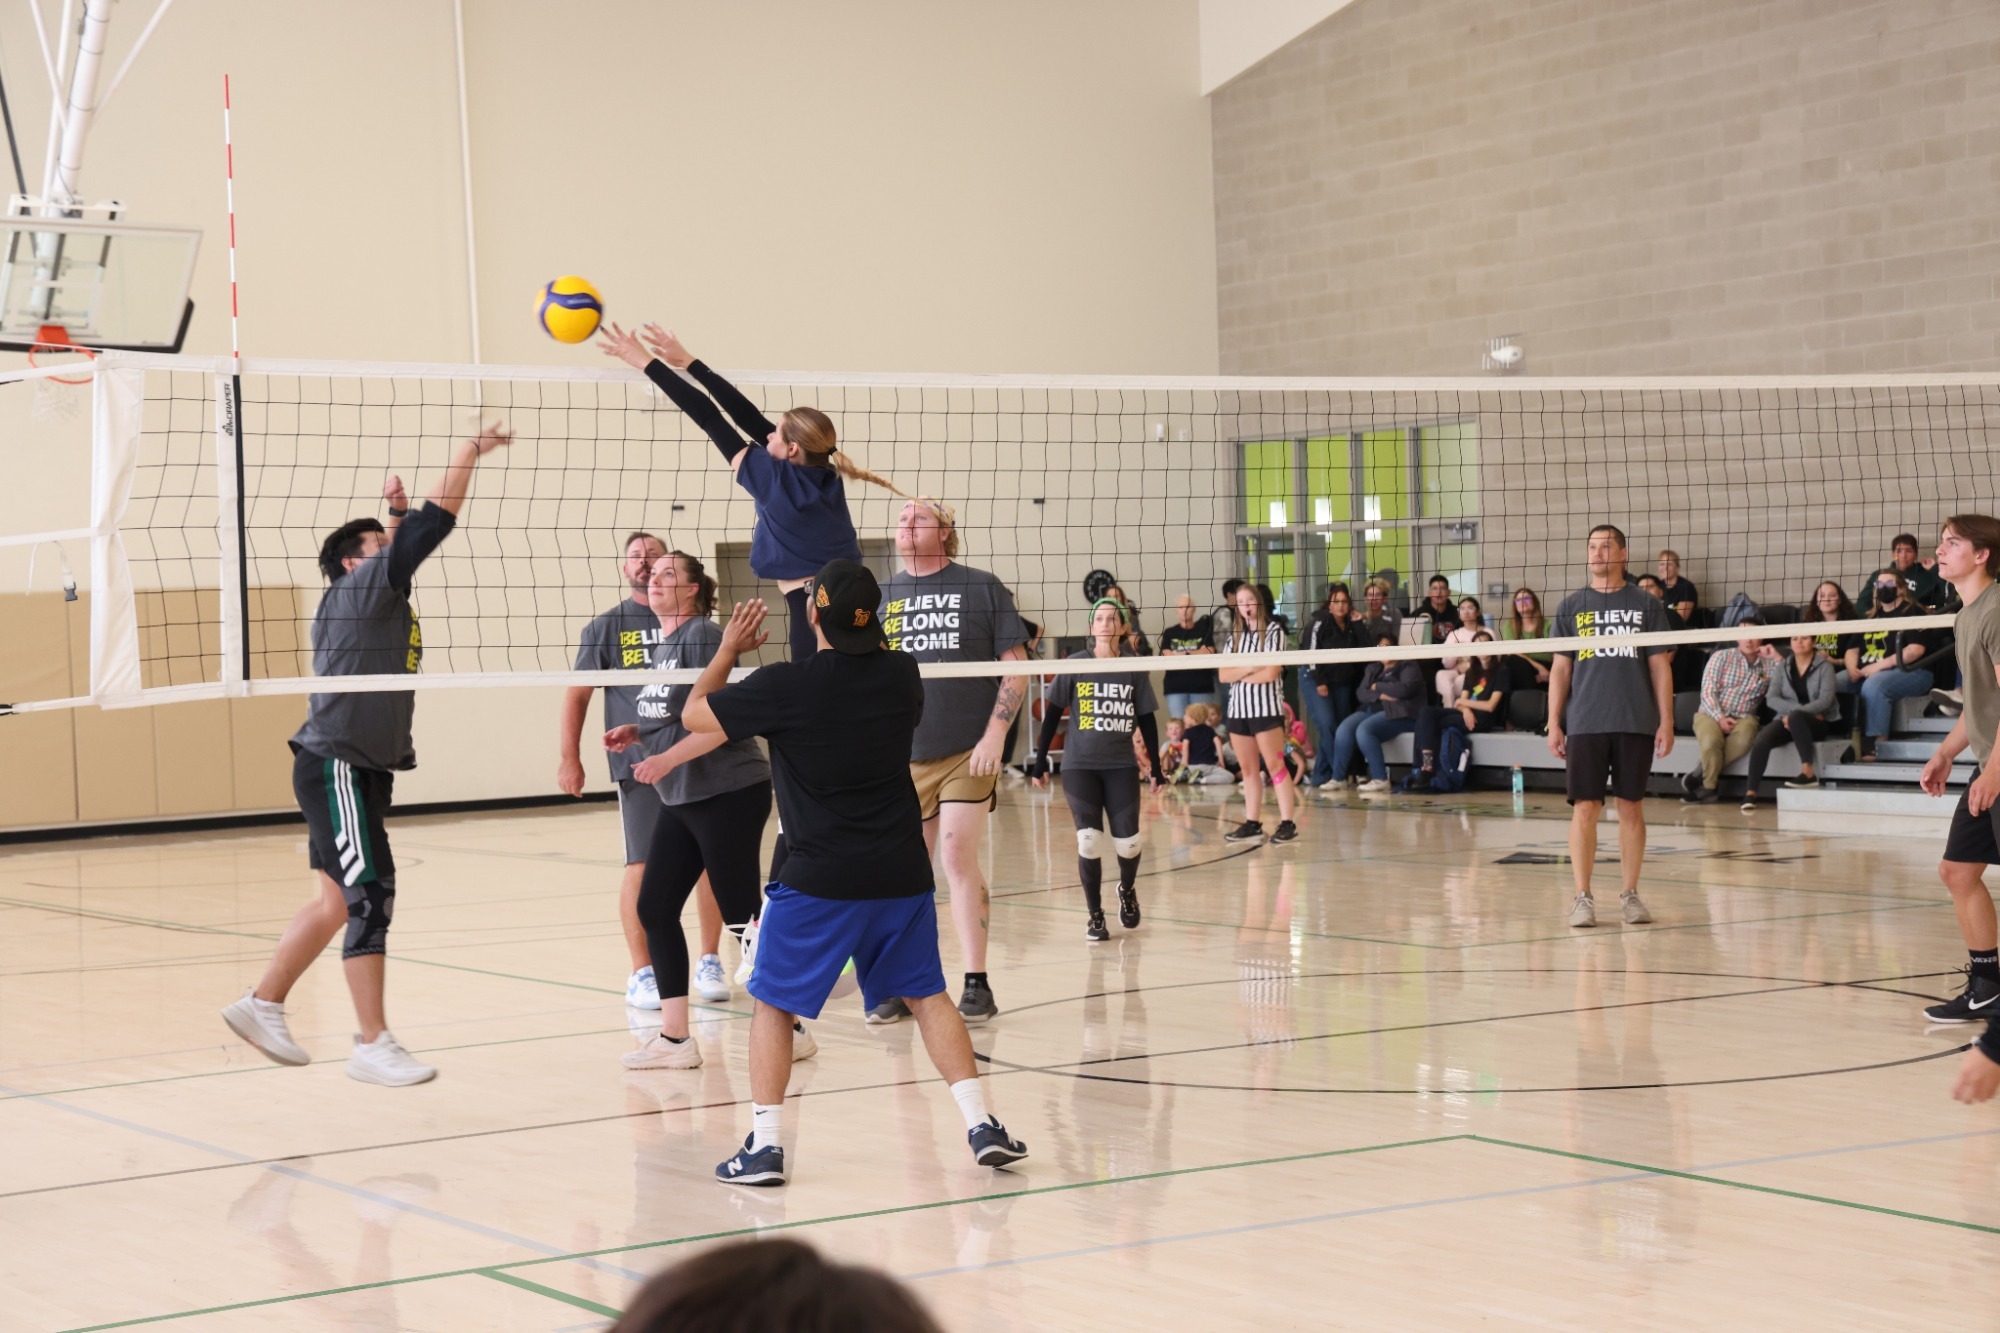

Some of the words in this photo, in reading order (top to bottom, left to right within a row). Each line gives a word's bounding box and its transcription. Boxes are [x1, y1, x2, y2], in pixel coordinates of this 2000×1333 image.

[883, 612, 960, 635] BELONG
[1575, 609, 1643, 629] BELIEVE
[622, 648, 652, 667] BEL
[637, 700, 671, 718] COME
[1079, 699, 1135, 717] BELONG
[1079, 715, 1134, 733] BECOME
